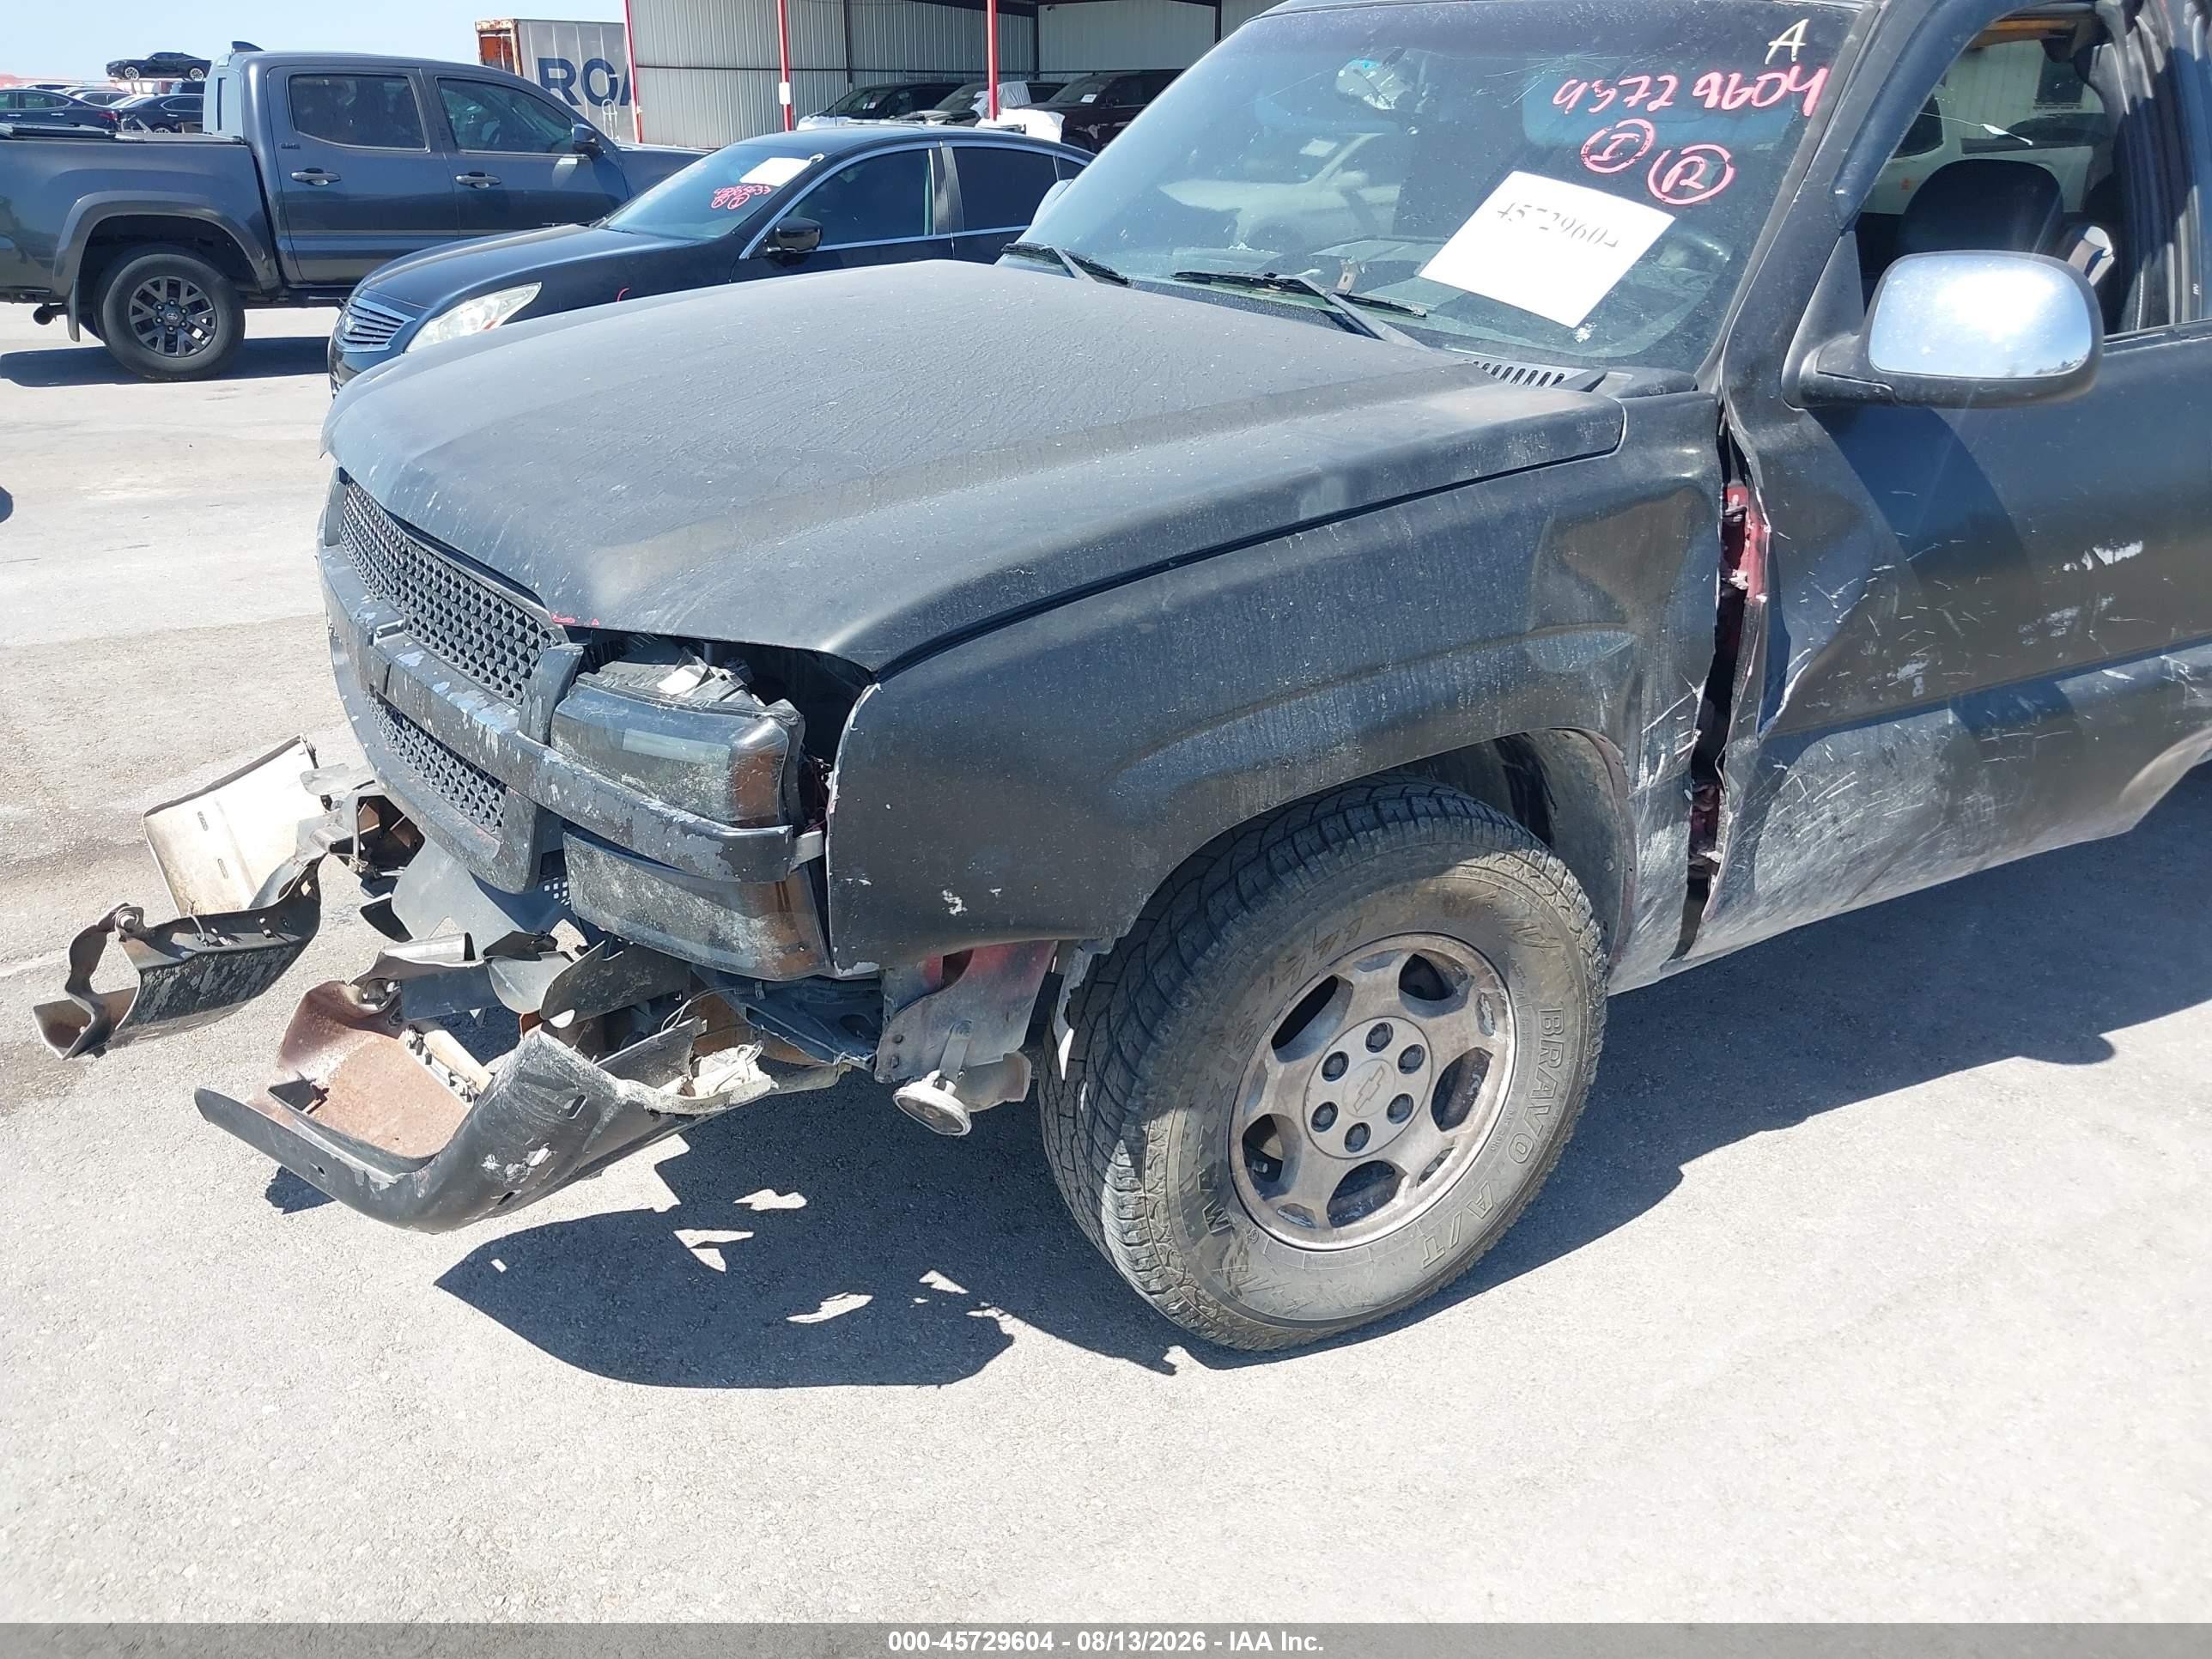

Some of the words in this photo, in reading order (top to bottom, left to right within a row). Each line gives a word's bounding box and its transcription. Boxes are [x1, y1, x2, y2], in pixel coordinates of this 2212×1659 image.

[1764, 18, 1809, 65] A
[1507, 1008, 1565, 1164] BRAVO
[1422, 1181, 1494, 1269] A/T
